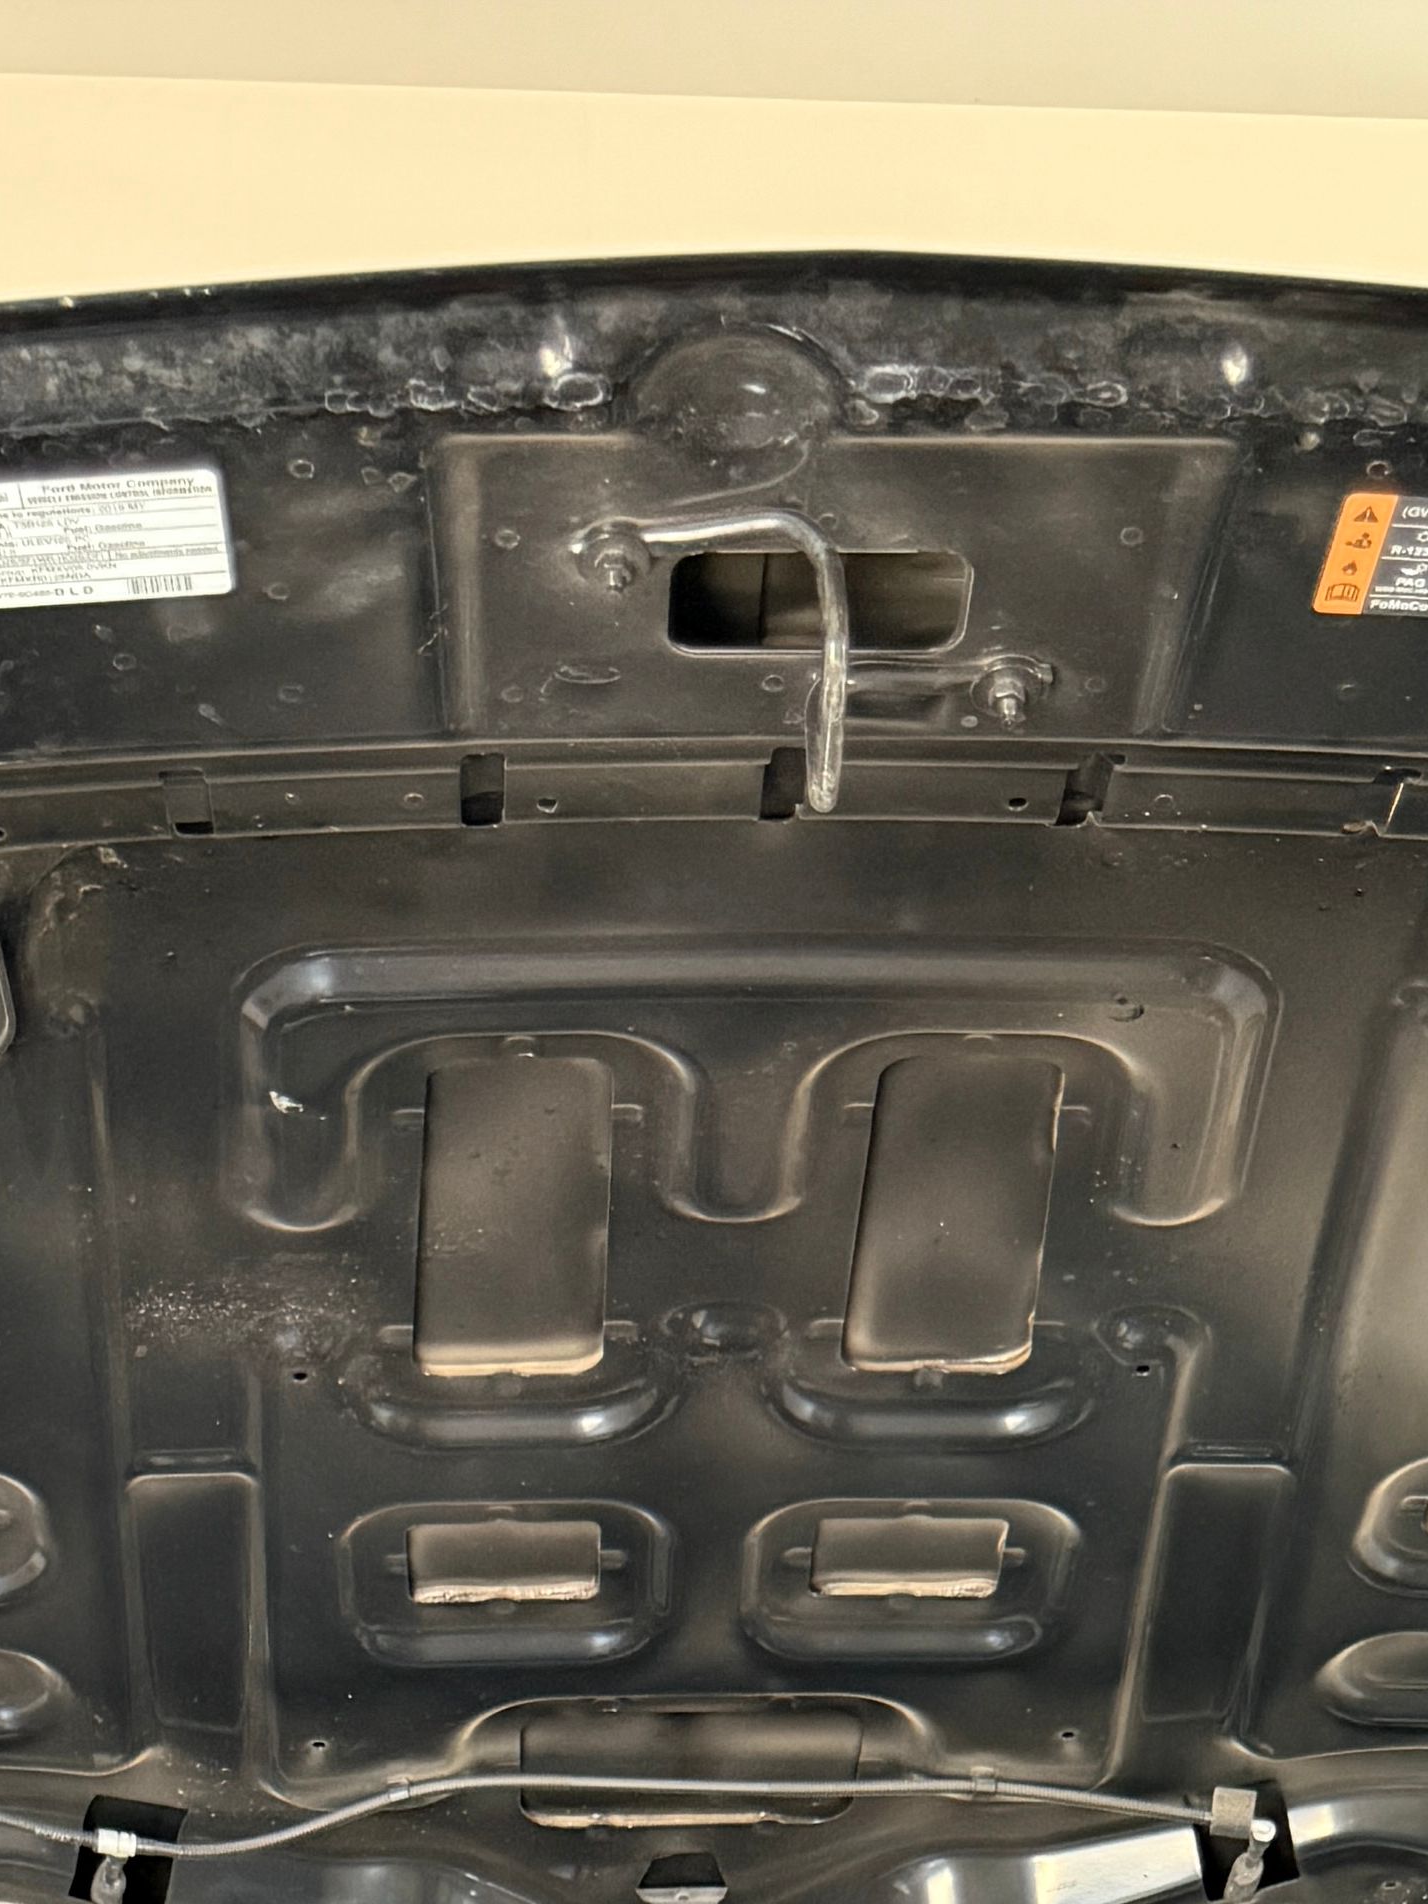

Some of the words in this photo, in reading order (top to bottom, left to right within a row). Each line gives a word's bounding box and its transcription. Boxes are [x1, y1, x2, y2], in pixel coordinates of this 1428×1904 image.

[41, 483, 75, 494] Ford
[80, 480, 121, 492] Motor
[126, 477, 194, 488] Company
[1370, 599, 1428, 612] FoMoCo
